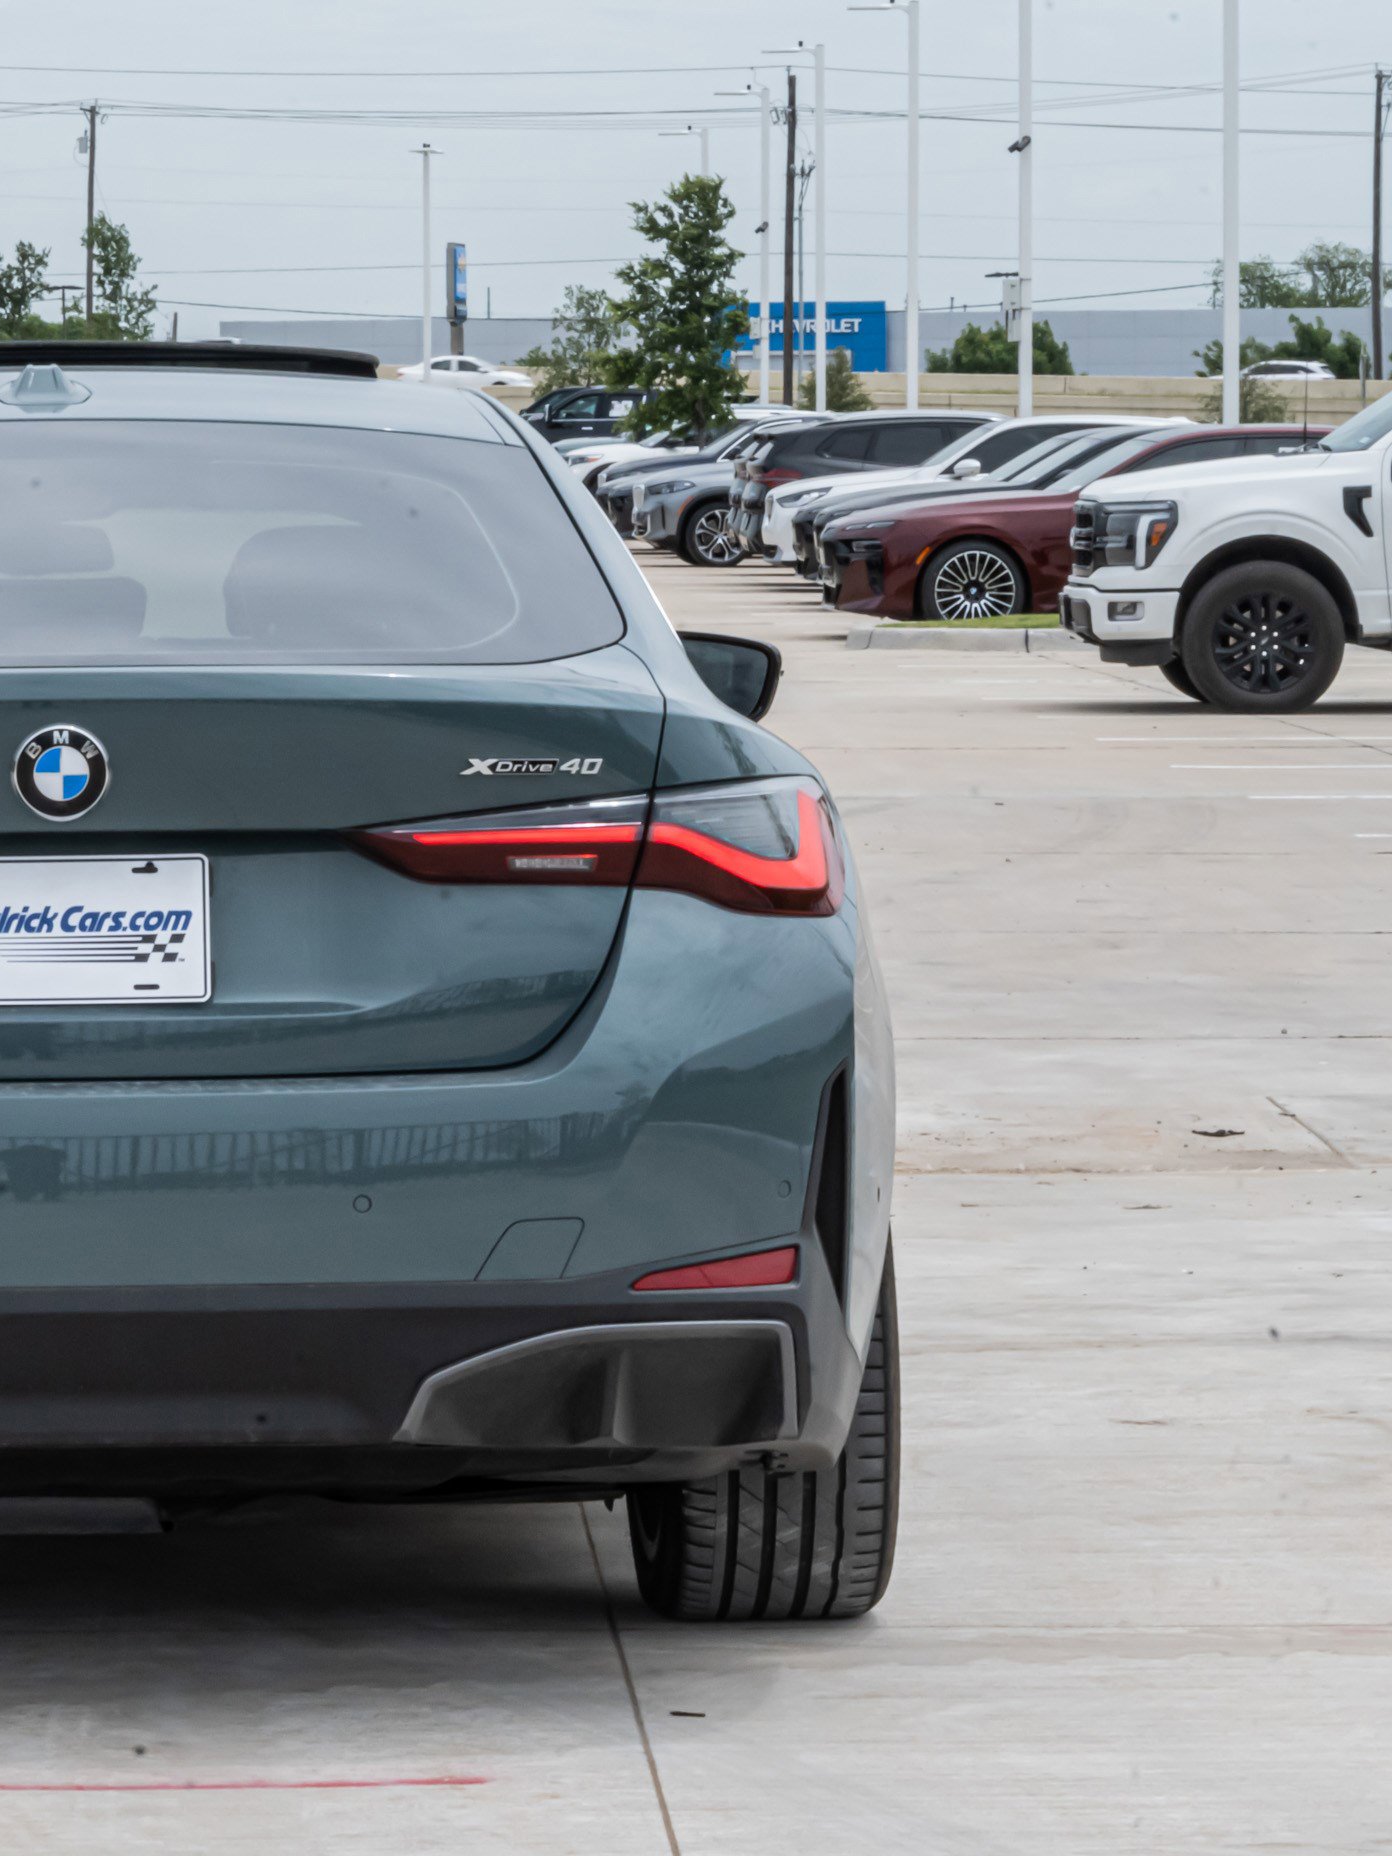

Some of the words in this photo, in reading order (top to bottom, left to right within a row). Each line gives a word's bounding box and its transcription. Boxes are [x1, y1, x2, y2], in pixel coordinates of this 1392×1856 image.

[764, 318, 862, 333] HVRLET
[25, 730, 99, 759] BMW
[560, 758, 603, 775] 40
